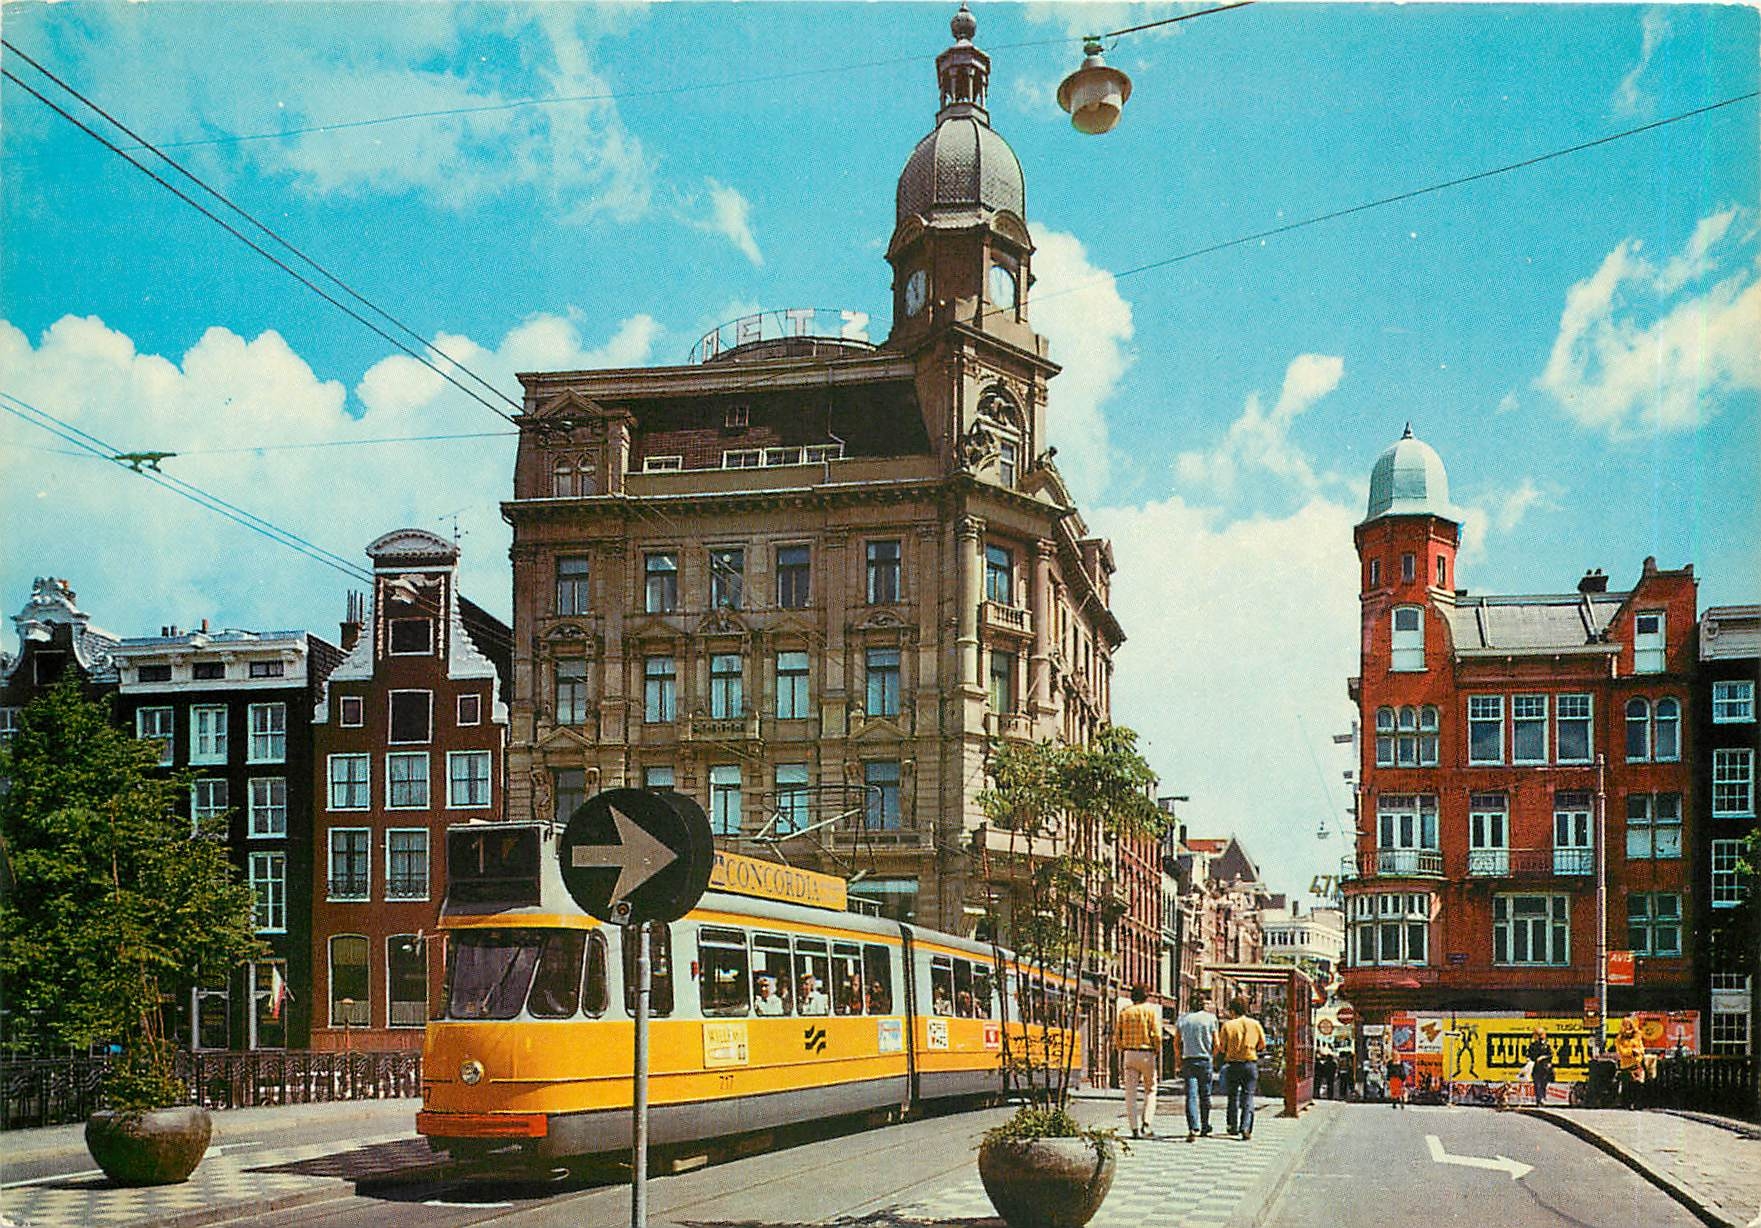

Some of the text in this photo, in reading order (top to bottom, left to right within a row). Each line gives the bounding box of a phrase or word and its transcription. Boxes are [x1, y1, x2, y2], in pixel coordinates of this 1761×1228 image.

[702, 308, 870, 363] METZ
[1610, 953, 1633, 963] AVIS
[1491, 1037, 1564, 1064] LUCY
